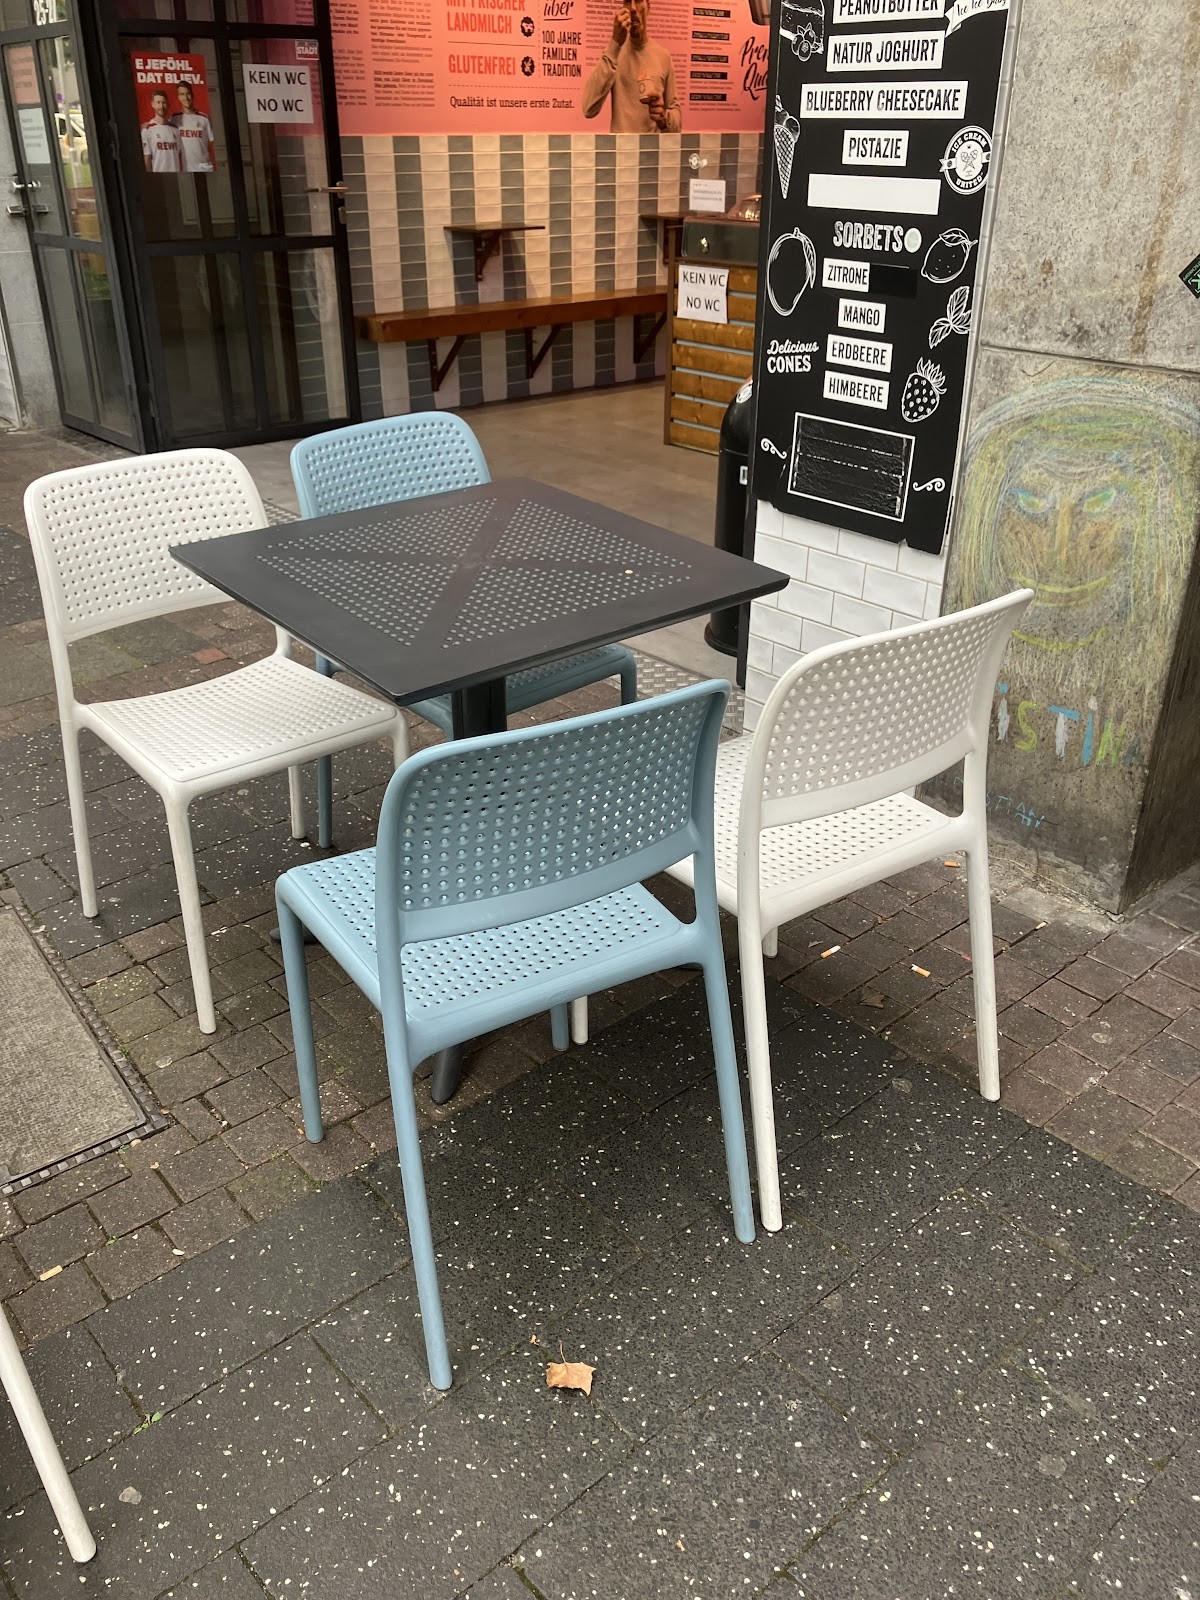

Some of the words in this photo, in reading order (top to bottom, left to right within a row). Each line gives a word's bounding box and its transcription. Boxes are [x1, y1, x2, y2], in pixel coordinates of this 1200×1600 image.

[447, 12, 513, 34] LANDMILCH
[542, 31, 555, 44] 100
[557, 32, 582, 46] JAHRE
[296, 46, 318, 55] STADT
[542, 47, 578, 62] FAMILIEN
[832, 41, 873, 64] NATUR
[876, 39, 939, 63] JOGHURT
[135, 58, 143, 70] E
[145, 56, 193, 71] JEFÖHL
[448, 54, 516, 76] GLUTENFREI
[542, 63, 582, 77] TRADITION
[137, 72, 164, 84] DAT
[248, 70, 281, 85] KEIN
[285, 71, 307, 85] WC
[257, 98, 278, 112] NO
[281, 99, 304, 112] WC
[450, 96, 484, 108] Qualität
[486, 97, 497, 108] ist
[499, 99, 527, 108] unsere
[529, 99, 550, 108] erste
[552, 98, 575, 109] Zutat.
[806, 90, 874, 112] BLUEBERRY
[877, 89, 961, 112] CHEESECAKE
[180, 129, 203, 139] REWE
[951, 137, 964, 153] ICE
[963, 132, 988, 148] CREAM
[848, 137, 903, 159] PISTAZIE
[955, 175, 983, 189] UNITED
[832, 220, 904, 253] SORBETS
[682, 270, 706, 285] KEIN
[709, 273, 726, 287] WC
[827, 264, 869, 285] ZITRONE
[686, 295, 702, 310] NO
[704, 297, 720, 312] WC
[843, 305, 881, 327] MANGO
[766, 339, 820, 355] Delicious
[831, 341, 887, 366] ERDBEERE
[766, 355, 812, 374] CONES
[828, 377, 884, 403] HIMBEERE
